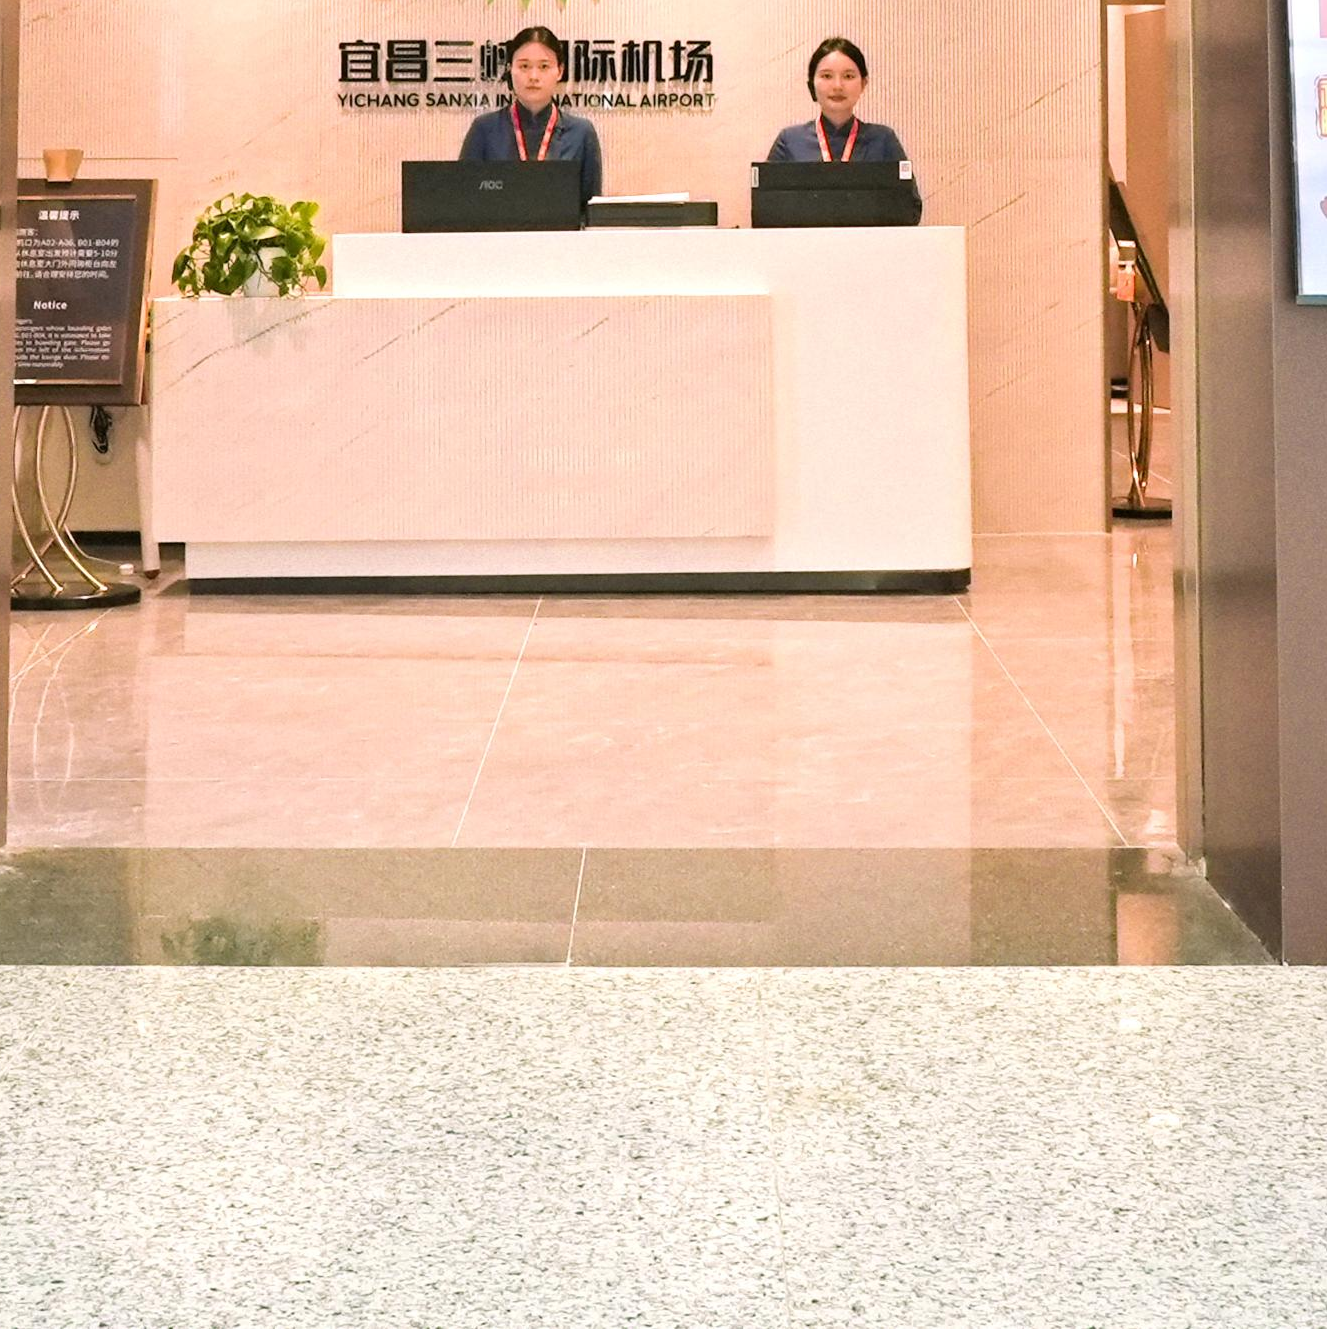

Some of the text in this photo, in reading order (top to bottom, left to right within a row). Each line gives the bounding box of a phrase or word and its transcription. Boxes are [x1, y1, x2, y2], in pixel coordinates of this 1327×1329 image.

[338, 39, 714, 83] 宜昌三峡际机场
[338, 93, 716, 108] YICHANG SANXIA INNATIONAL AIRPORT
[33, 300, 68, 310] Notice
